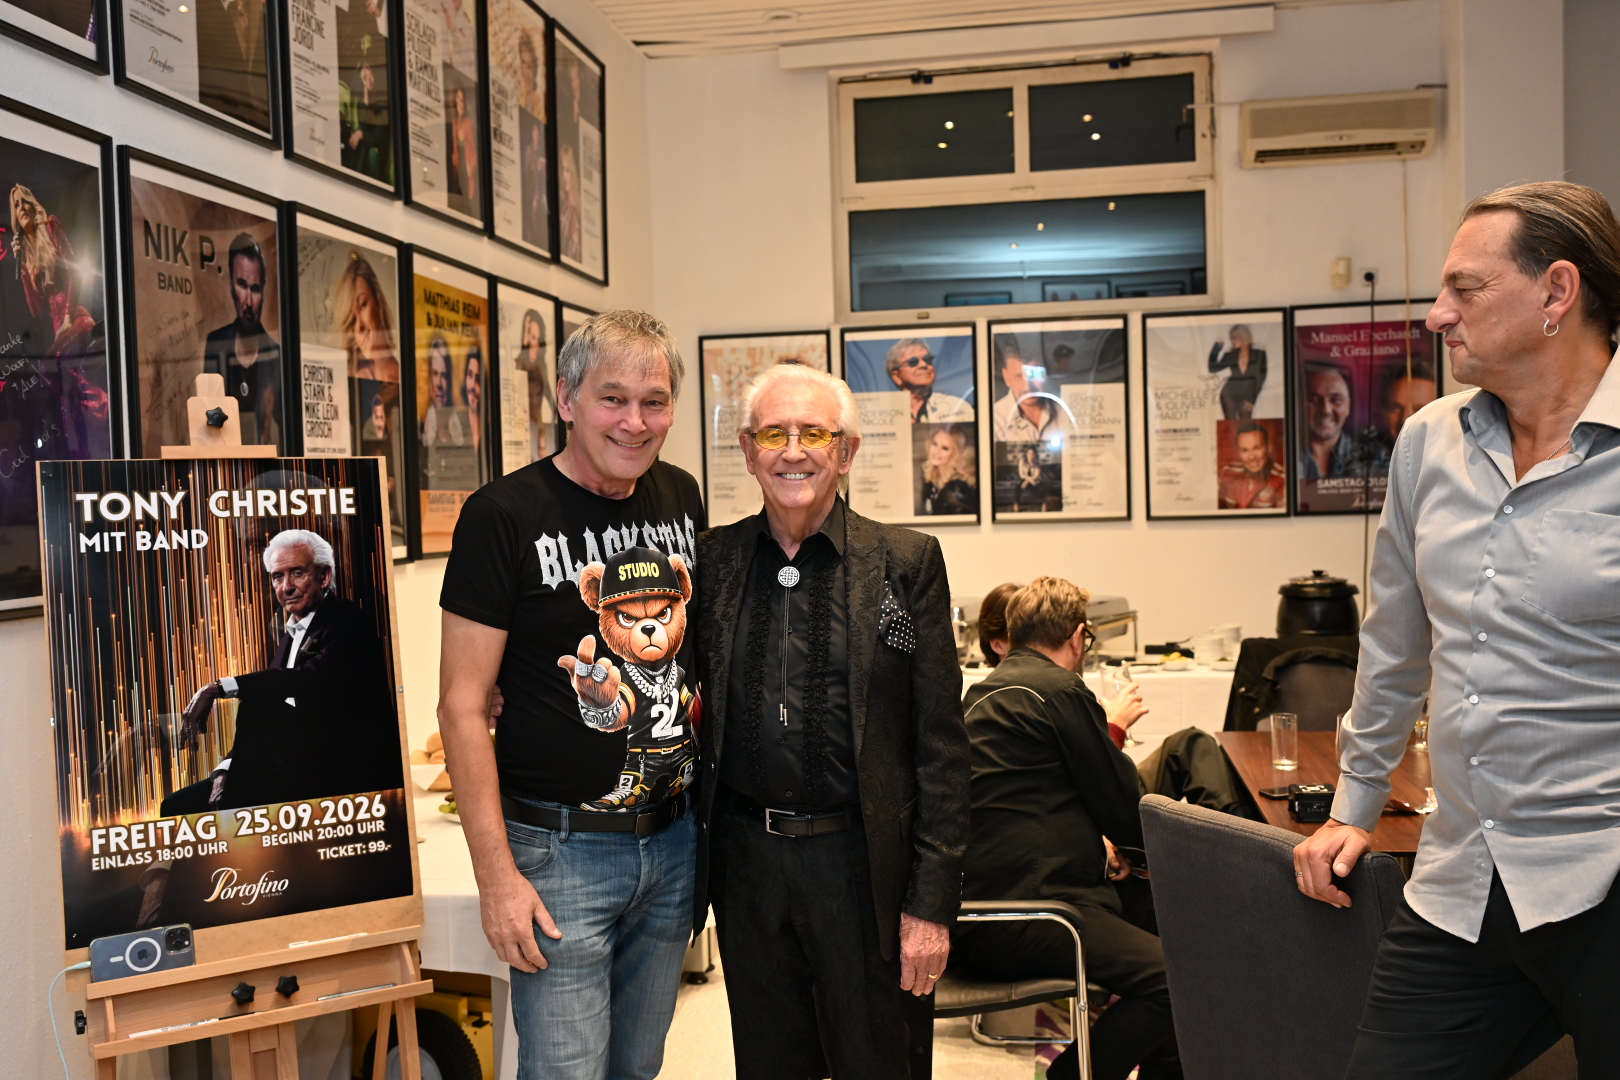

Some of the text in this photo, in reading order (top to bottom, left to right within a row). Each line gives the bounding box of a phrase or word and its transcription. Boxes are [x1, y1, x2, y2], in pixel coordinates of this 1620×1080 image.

[144, 219, 223, 275] NIK P.
[158, 272, 192, 295] BAND
[424, 288, 481, 320] MATTHIAS REIM
[1311, 327, 1421, 344] Manuel Eerhadt
[1330, 345, 1341, 357] &
[303, 364, 334, 384] CHRISTIN
[304, 383, 326, 401] STARK
[305, 402, 339, 421] MIKE LEON
[859, 408, 904, 419] NDERSON
[305, 420, 333, 438] GROSCH
[75, 487, 357, 522] TONY CHRISTIE
[79, 530, 209, 553] MIT BAND
[618, 562, 660, 581] STUDIO
[91, 794, 387, 855] FREITAG 25.09.2026
[262, 820, 386, 848] BEGINN 20:00 UHR
[92, 841, 229, 871] EINLASS 18:00 UHR
[318, 843, 367, 860] TICKET:
[204, 867, 289, 906] Portofino
